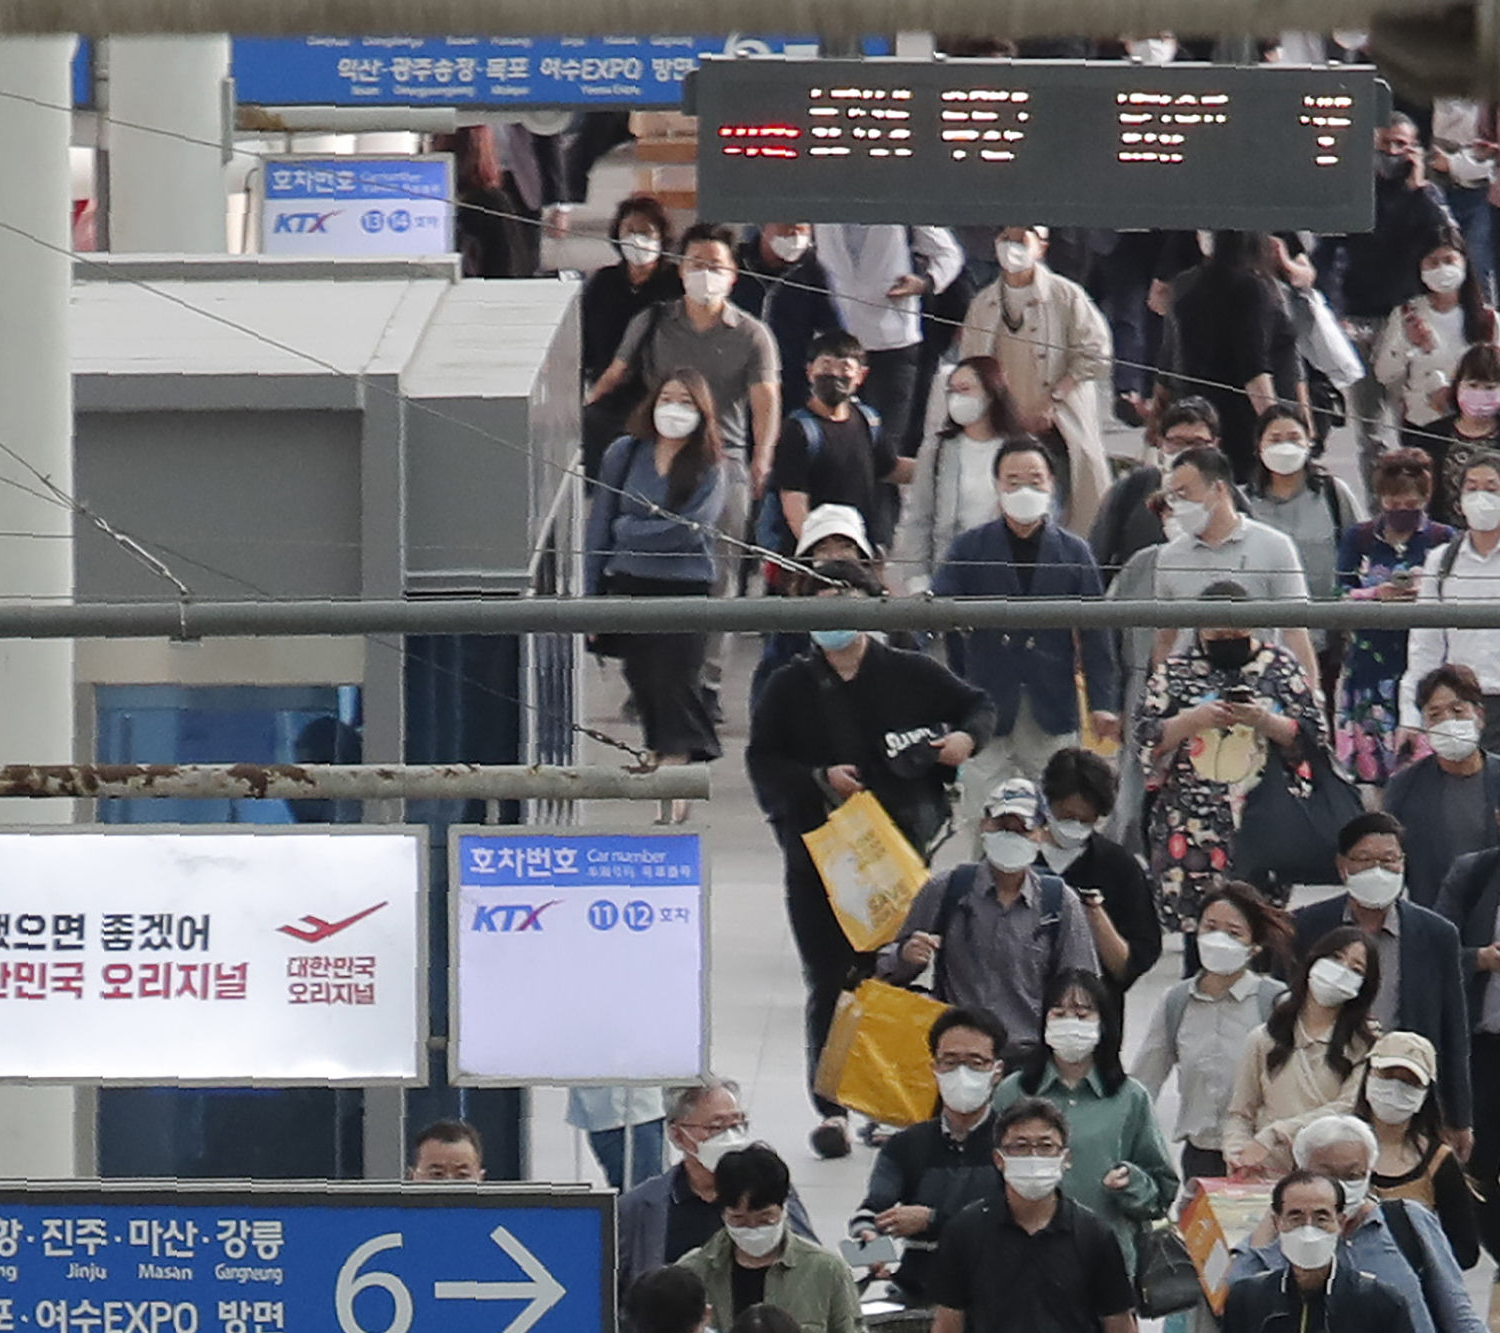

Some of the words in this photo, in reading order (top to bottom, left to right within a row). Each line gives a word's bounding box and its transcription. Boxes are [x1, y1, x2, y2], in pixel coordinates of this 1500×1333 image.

[273, 210, 337, 234] KTX
[469, 846, 580, 878] 호차번호
[100, 912, 211, 952] 좋겠어
[471, 902, 552, 932] KTX
[659, 906, 691, 923] 호차
[100, 961, 249, 1001] 오리지널
[286, 955, 378, 981] 대한민국
[286, 981, 377, 1007] 오리지널
[40, 1217, 109, 1259] 진주
[128, 1217, 199, 1258] 마산
[216, 1217, 285, 1260] 강릉
[66, 1262, 107, 1284] Jinju
[138, 1262, 193, 1281] Masan
[214, 1262, 284, 1285] Gangneung
